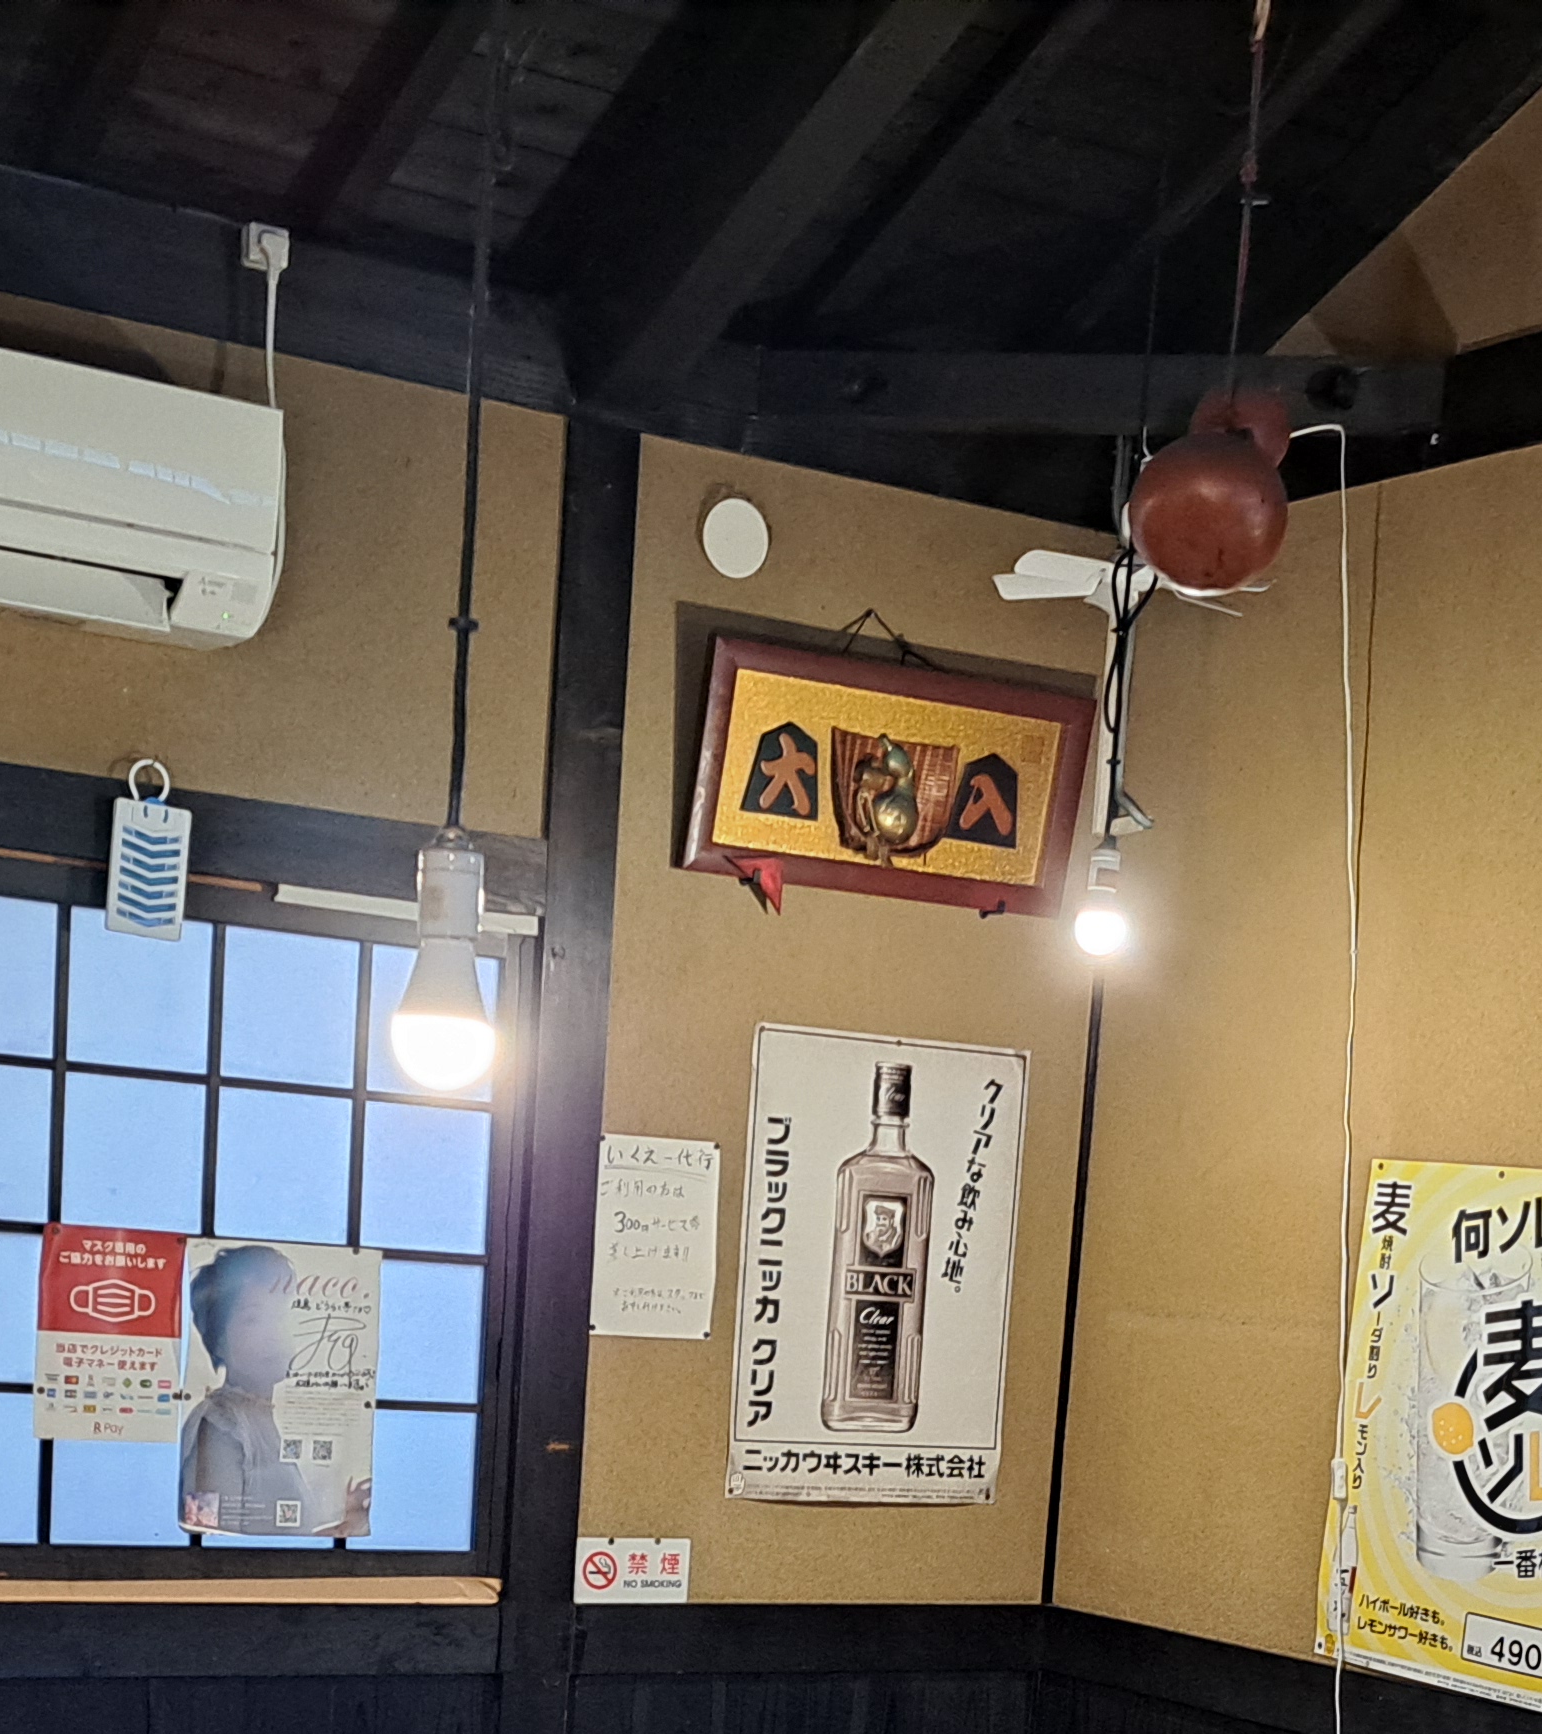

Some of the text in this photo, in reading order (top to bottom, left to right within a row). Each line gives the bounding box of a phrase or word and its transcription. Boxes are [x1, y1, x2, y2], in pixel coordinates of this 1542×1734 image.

[759, 732, 817, 817] 大
[941, 1077, 1004, 1294] クリアな飲み心地。
[746, 1116, 793, 1429] ブラックニッカ クリア
[846, 1269, 913, 1295] BLACK
[859, 1307, 895, 1325] Clear
[55, 1342, 163, 1358] 当店でクレジットカード
[742, 1449, 987, 1479] ニッカウヰスキー株式会社
[627, 1552, 681, 1575] 禁煙
[623, 1579, 682, 1589] NO SMOKING
[1359, 1593, 1446, 1627] ハイボール好きも。
[1357, 1615, 1454, 1653] レモンサワー好きも。
[1490, 1636, 1542, 1671] 490
